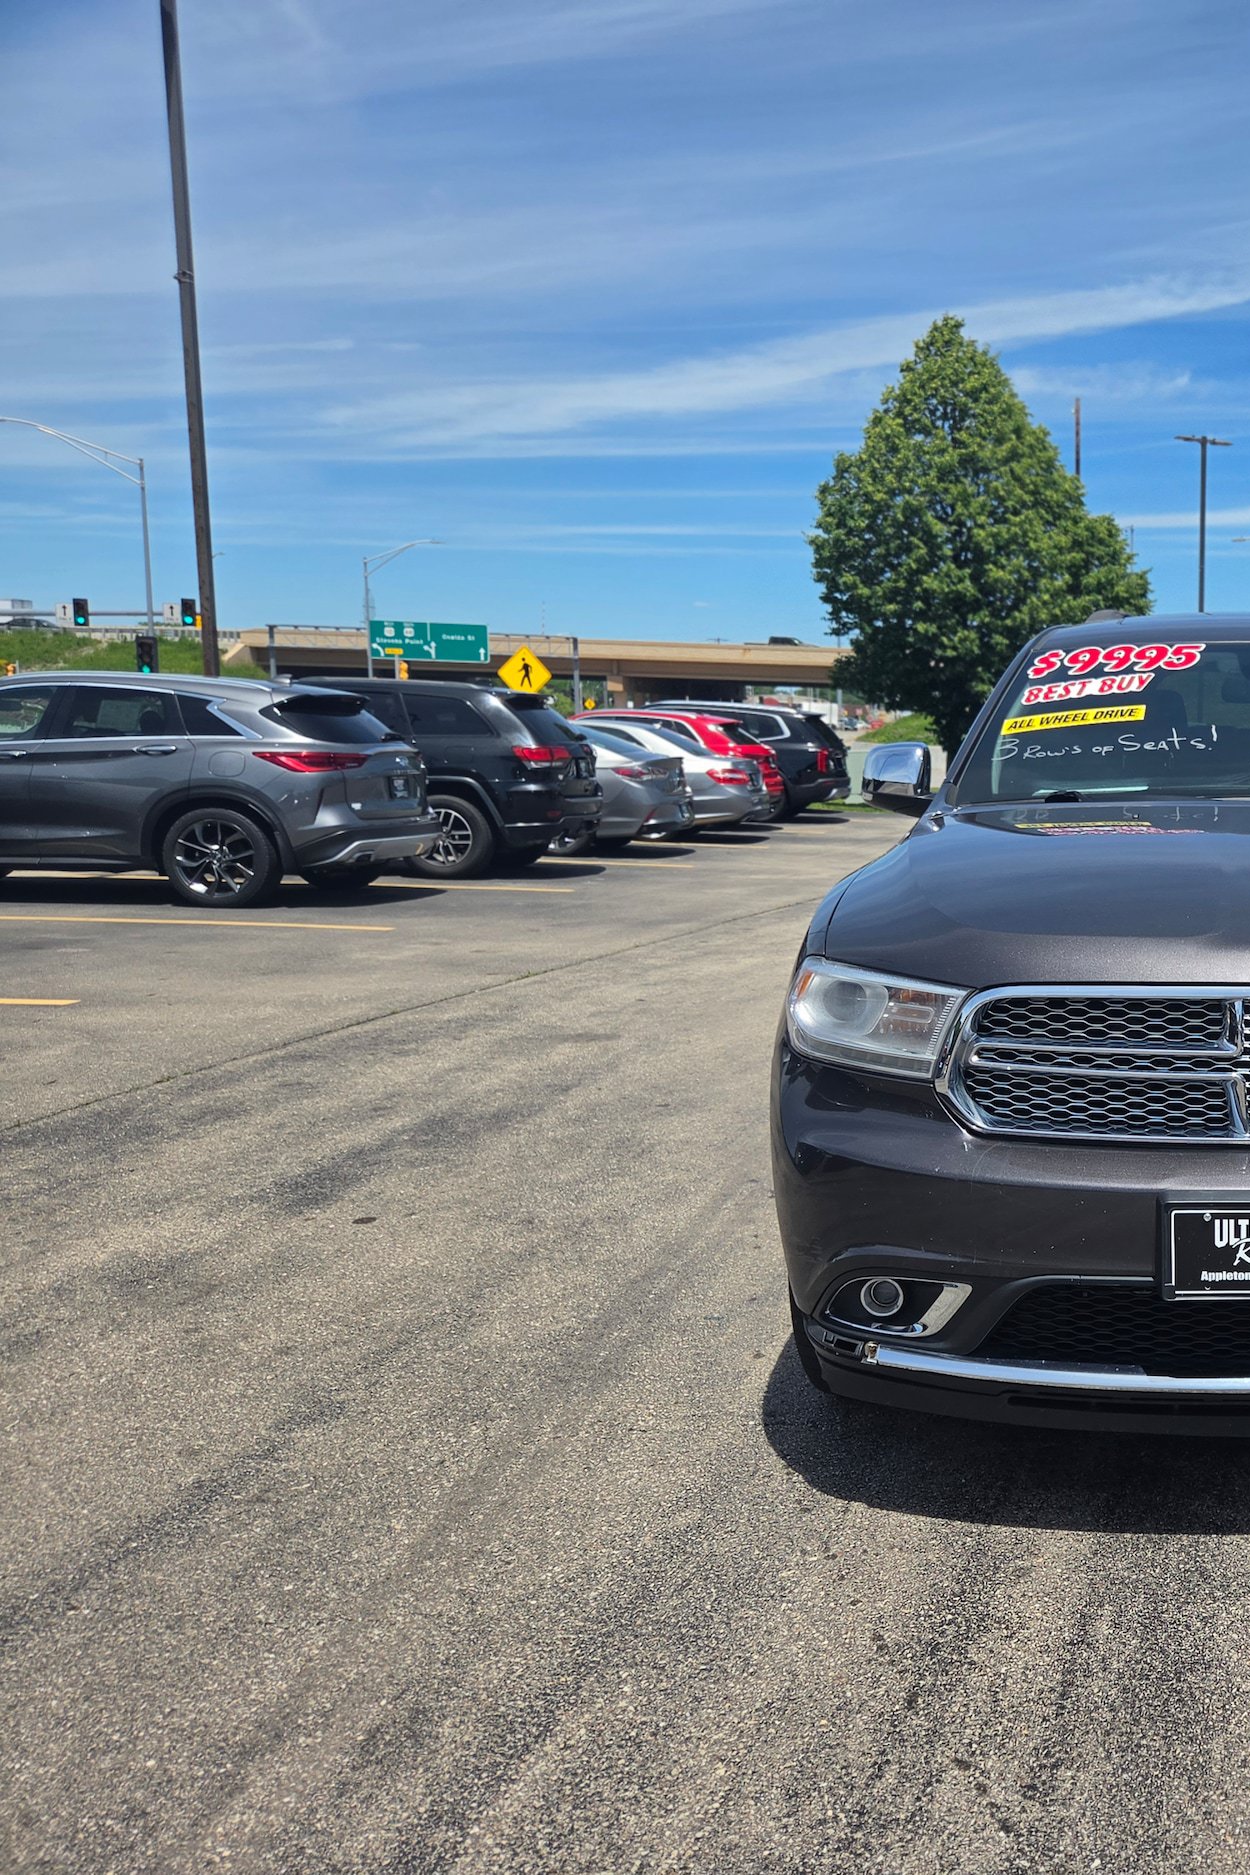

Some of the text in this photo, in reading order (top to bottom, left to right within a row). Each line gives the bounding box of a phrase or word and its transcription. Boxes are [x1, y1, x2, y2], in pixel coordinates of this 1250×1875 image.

[404, 637, 424, 645] Point
[1028, 644, 1206, 679] $9995
[1022, 673, 1155, 705] BEST BUY
[1008, 707, 1139, 731] ALL WHEEL DRIVE
[991, 738, 1019, 761] 3
